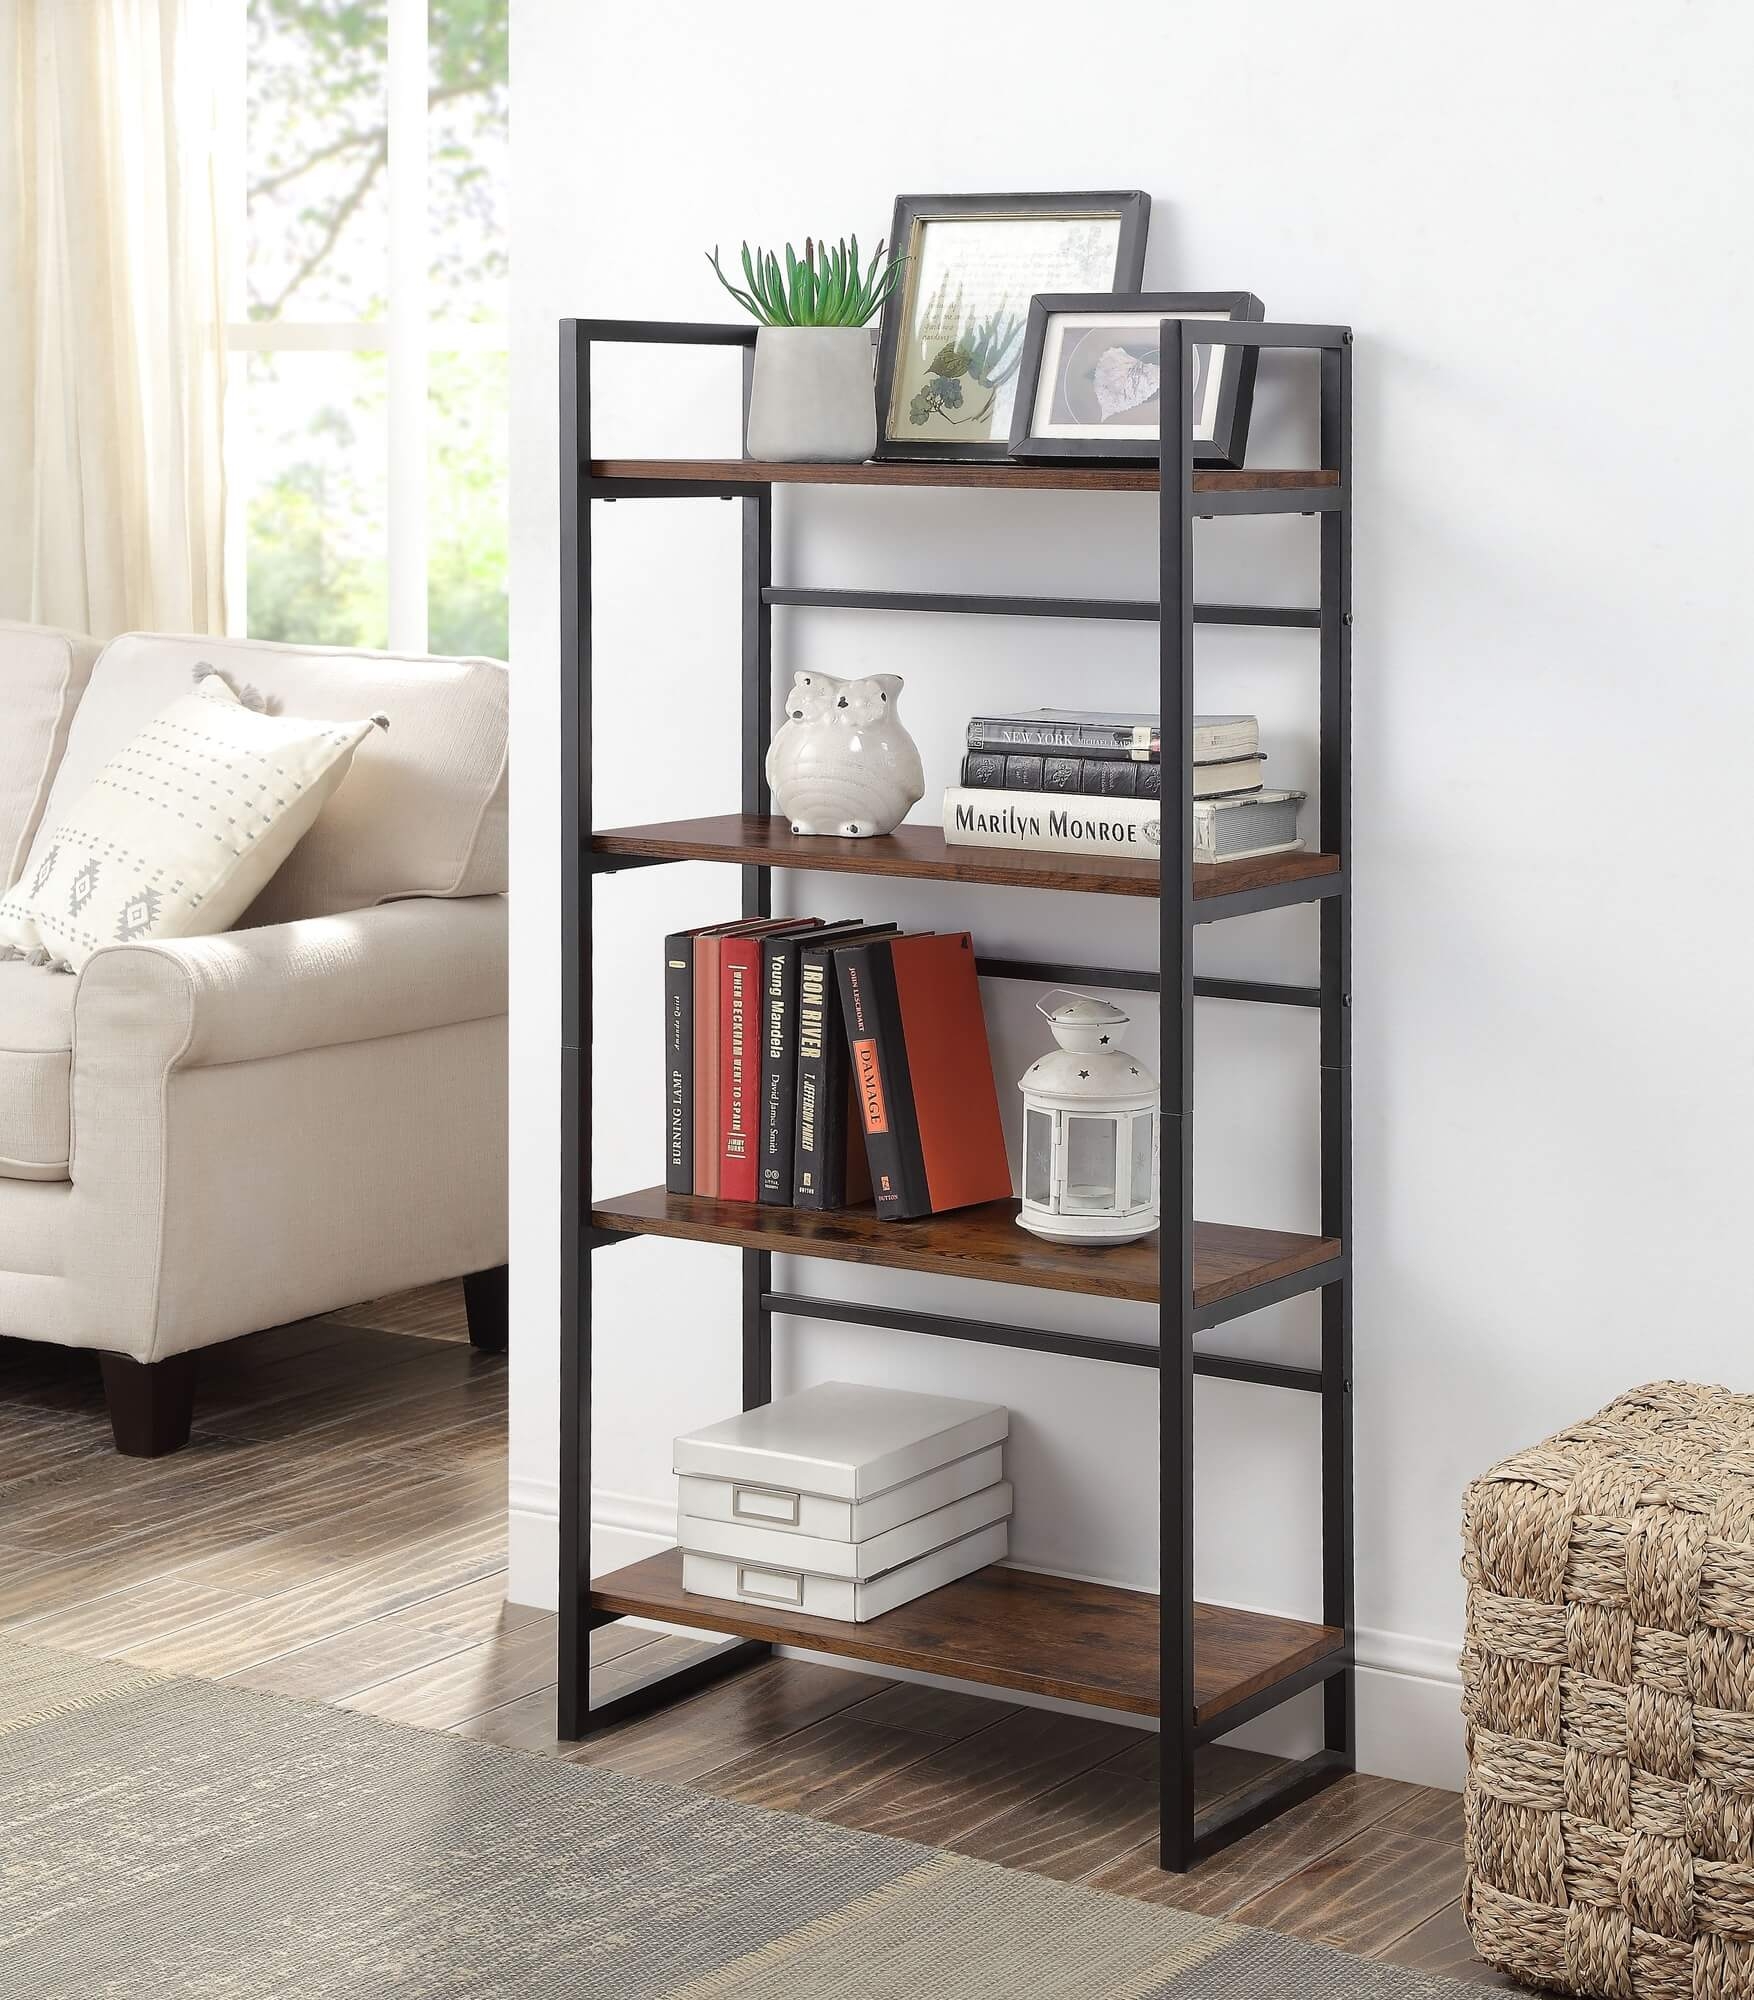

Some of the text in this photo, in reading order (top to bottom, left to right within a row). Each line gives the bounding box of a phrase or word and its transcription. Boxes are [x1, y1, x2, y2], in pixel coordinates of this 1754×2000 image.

[1003, 731, 1073, 746] NEW YORK
[770, 955, 785, 1058] Young Mandela
[801, 964, 824, 1058] IRON RIVER
[849, 967, 857, 989] JOHN
[732, 971, 743, 1131] WHEN BECKHAM WENT TO SPAIN
[860, 1050, 882, 1125] DAMAGE
[672, 1070, 683, 1165] BURNING LAMP
[769, 1074, 780, 1154] David James Smith
[801, 1122, 815, 1152] PARKER
[802, 1081, 816, 1122] JEFFERSON
